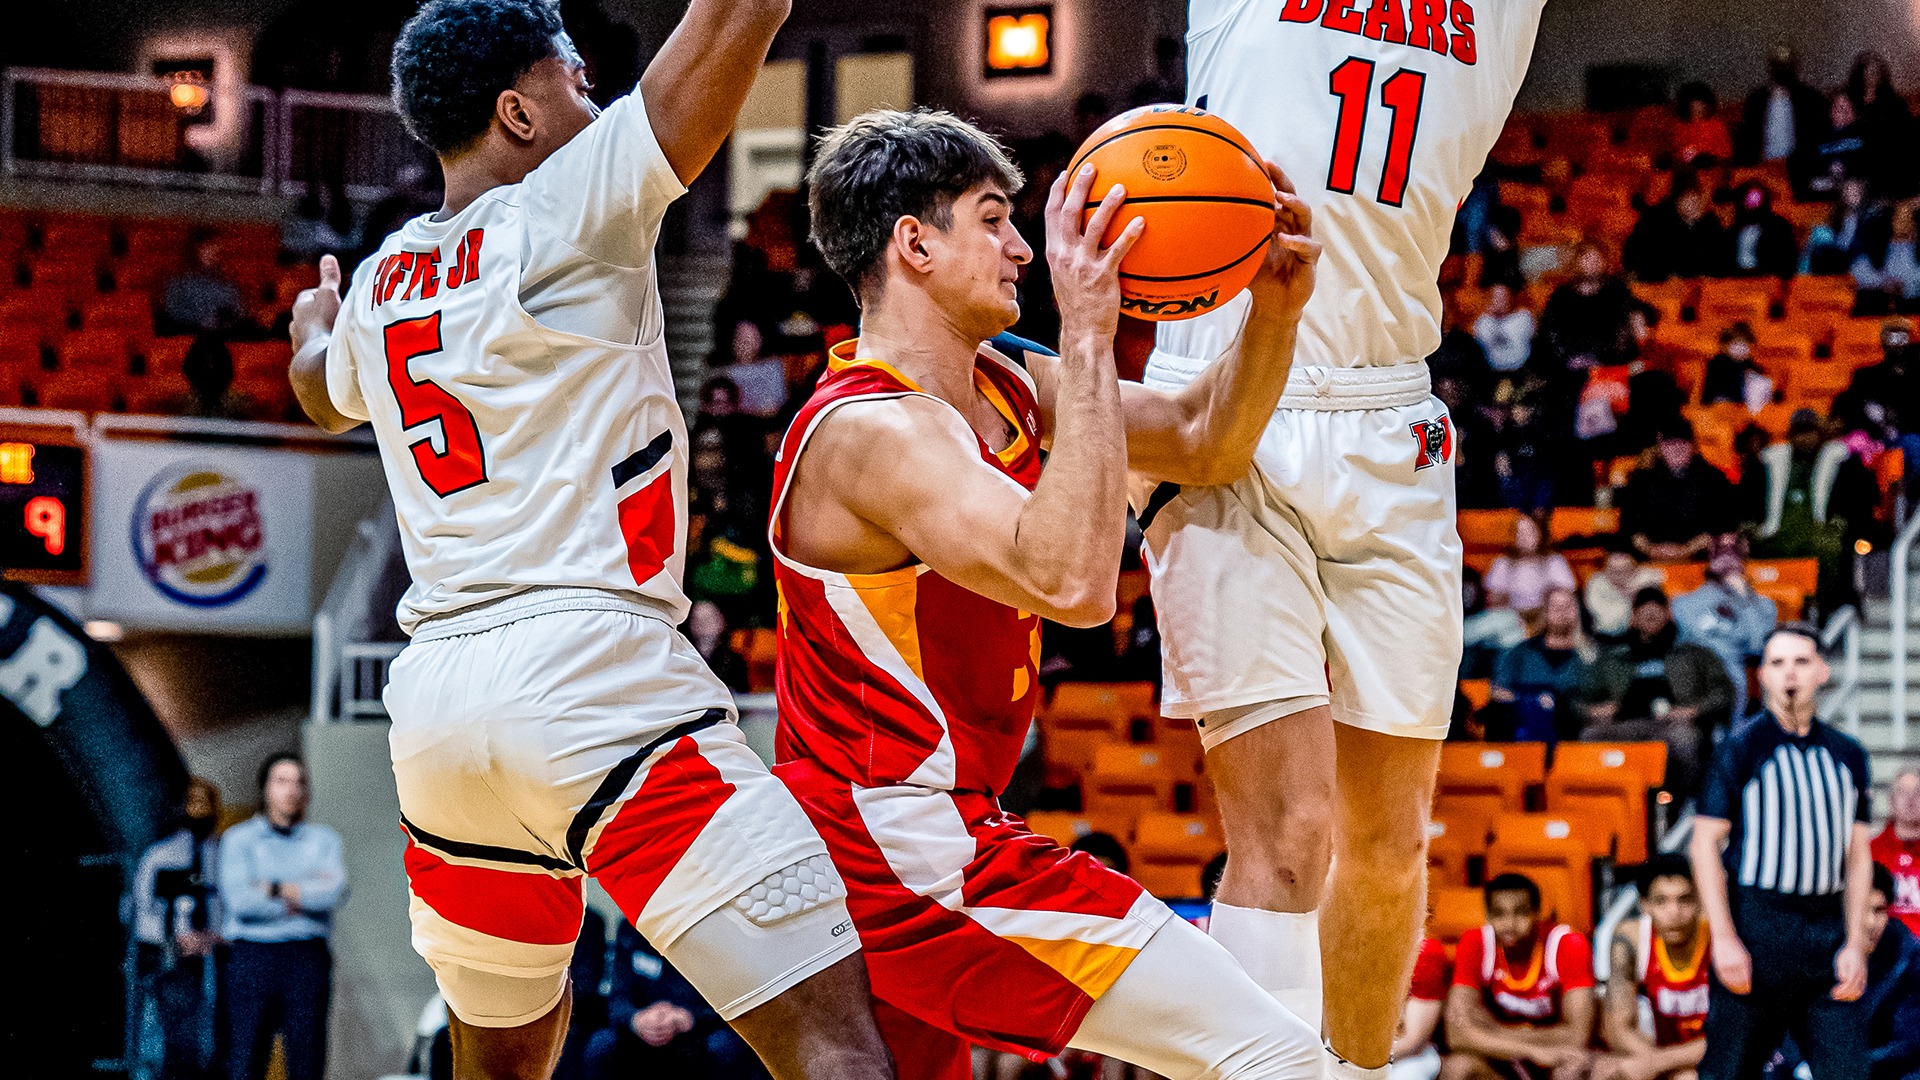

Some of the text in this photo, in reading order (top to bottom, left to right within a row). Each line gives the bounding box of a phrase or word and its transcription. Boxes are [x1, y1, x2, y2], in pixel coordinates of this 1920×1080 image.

[1326, 55, 1427, 208] 11
[446, 227, 485, 290] JR
[383, 309, 489, 499] 5
[24, 496, 65, 555] 9
